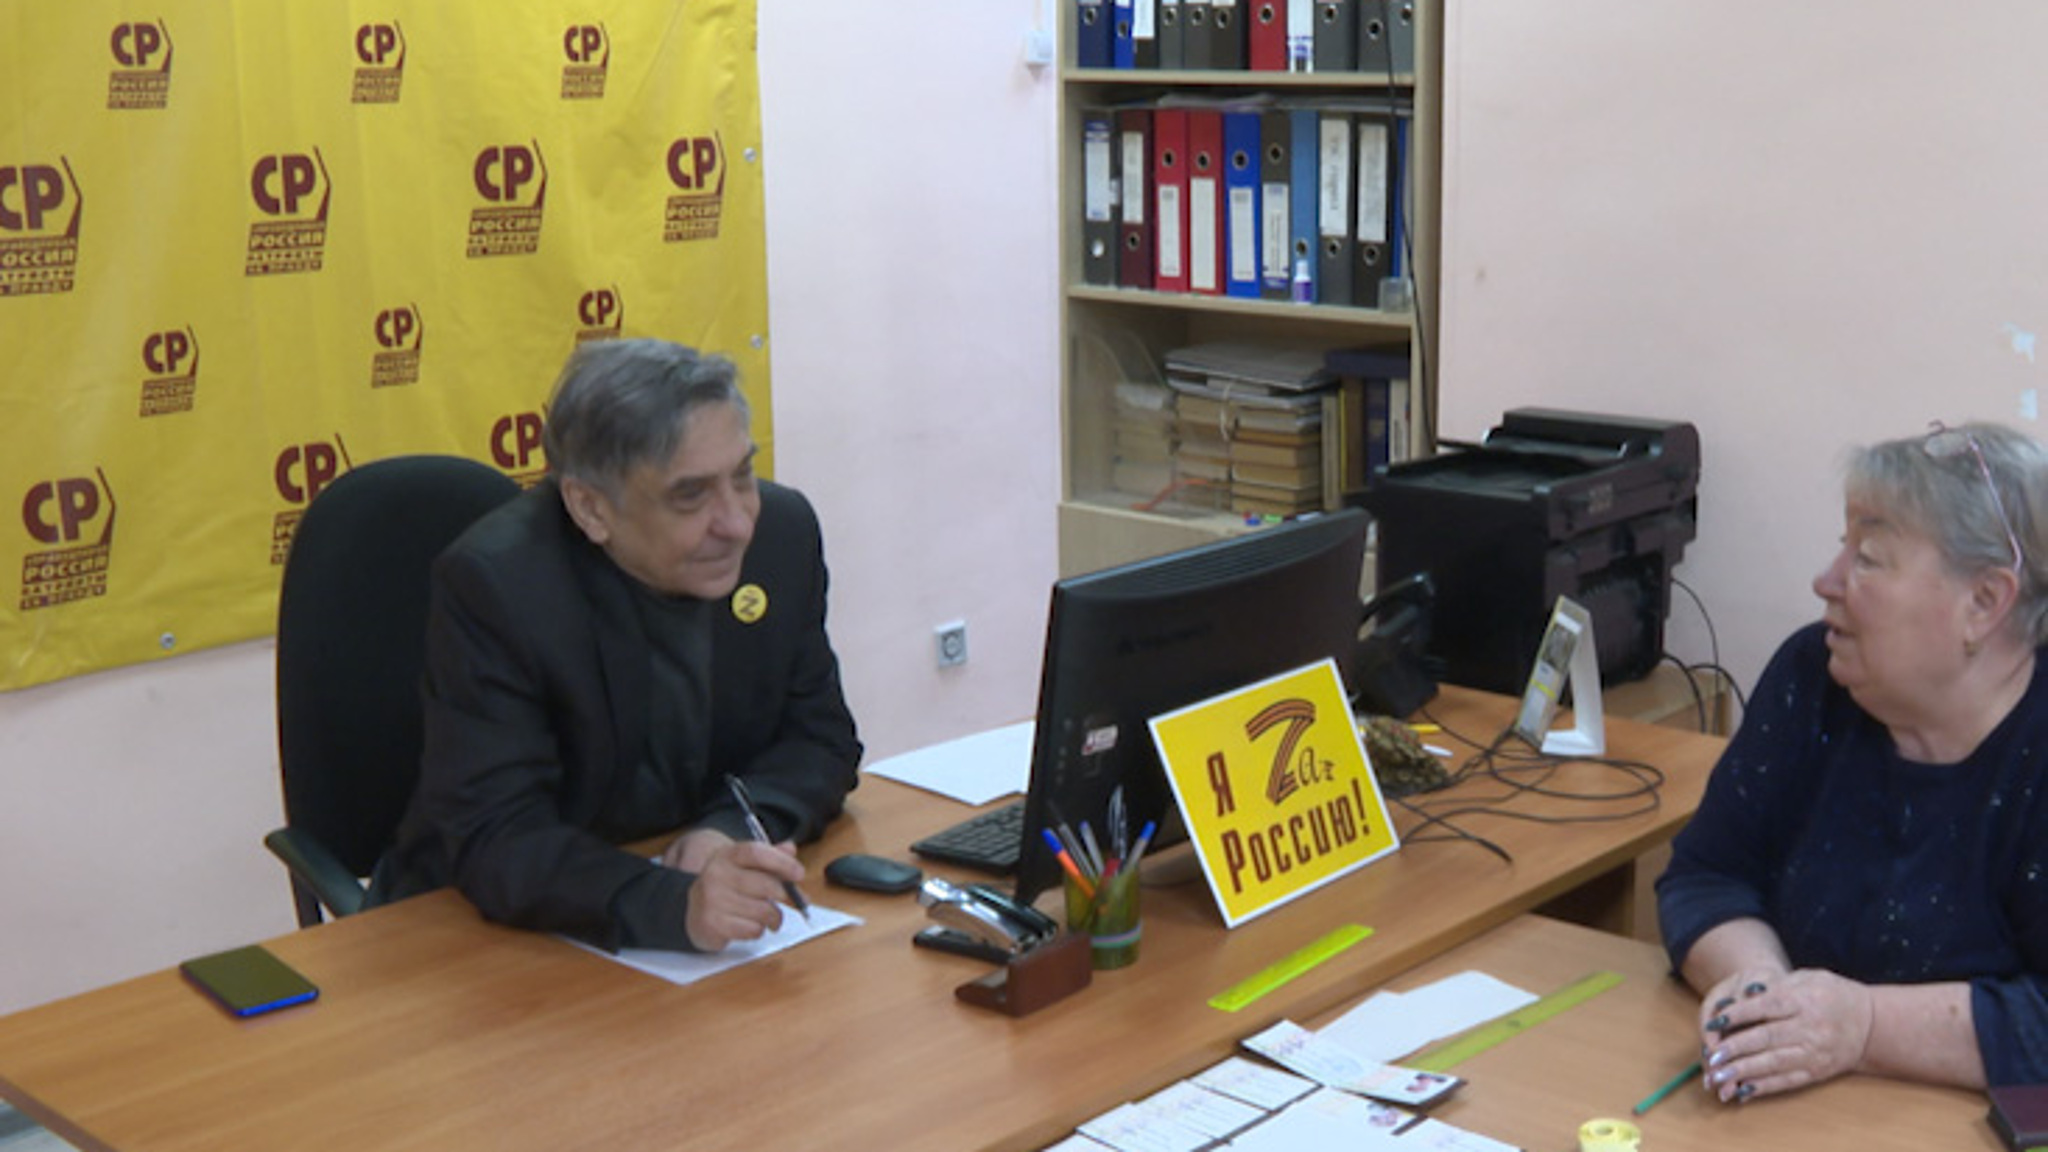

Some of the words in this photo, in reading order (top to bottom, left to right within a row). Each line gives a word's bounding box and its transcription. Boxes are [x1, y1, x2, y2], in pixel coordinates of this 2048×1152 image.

[111, 22, 161, 66] СР
[355, 24, 396, 64] СР
[563, 25, 602, 63] СР
[251, 154, 317, 215] СР
[473, 145, 535, 201] СР
[666, 137, 717, 190] СР
[0, 248, 75, 269] ОССИЯ
[374, 307, 414, 348] СР
[578, 289, 615, 326] СР
[142, 331, 189, 374] СР
[490, 412, 543, 469] СР
[275, 442, 338, 504] СР
[22, 477, 99, 544] СР
[1207, 751, 1236, 817] Я
